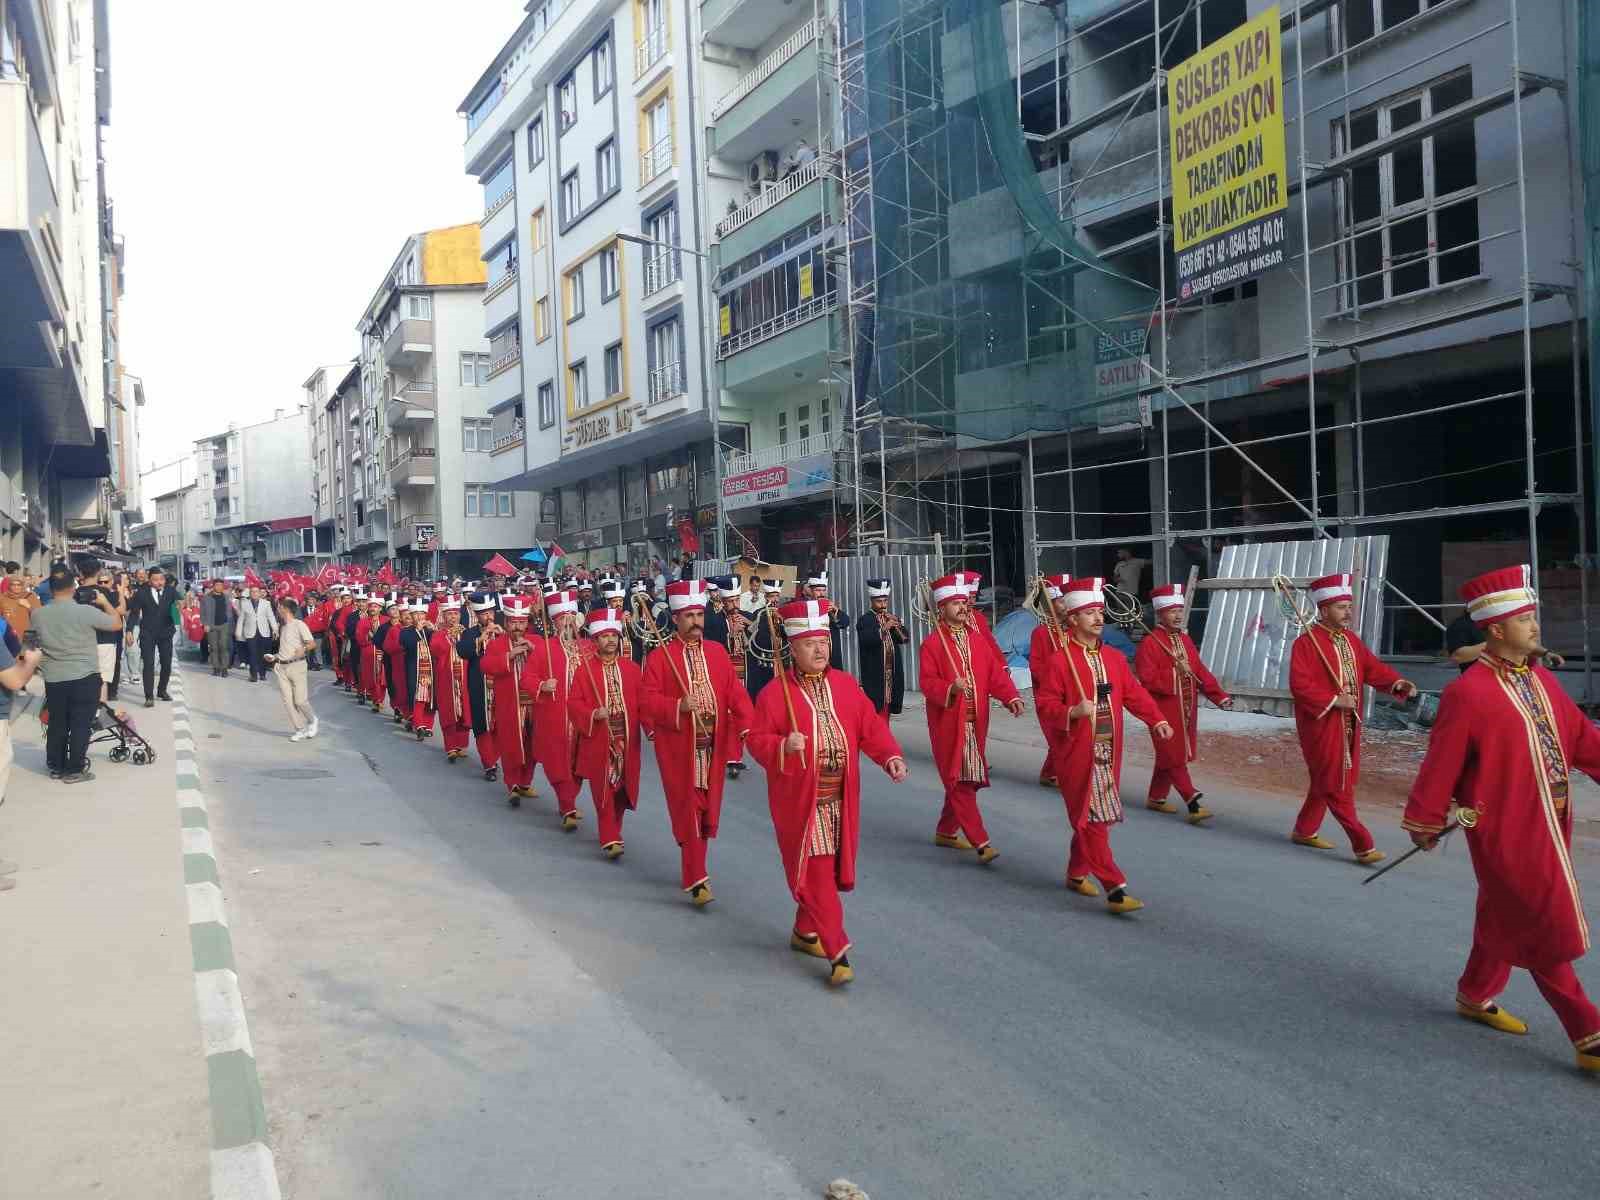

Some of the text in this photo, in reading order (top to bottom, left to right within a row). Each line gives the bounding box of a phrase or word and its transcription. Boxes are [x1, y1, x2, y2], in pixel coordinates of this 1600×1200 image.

[1176, 26, 1270, 115] SÜSLER YAPI
[1175, 75, 1275, 163] DEKORASYON
[1186, 133, 1263, 200] TARAFINDAN
[1179, 172, 1279, 243] YAPILMAKTADIR
[1263, 221, 1273, 246] 40
[1273, 216, 1284, 242] 01
[1212, 262, 1249, 285] DEKORASYON
